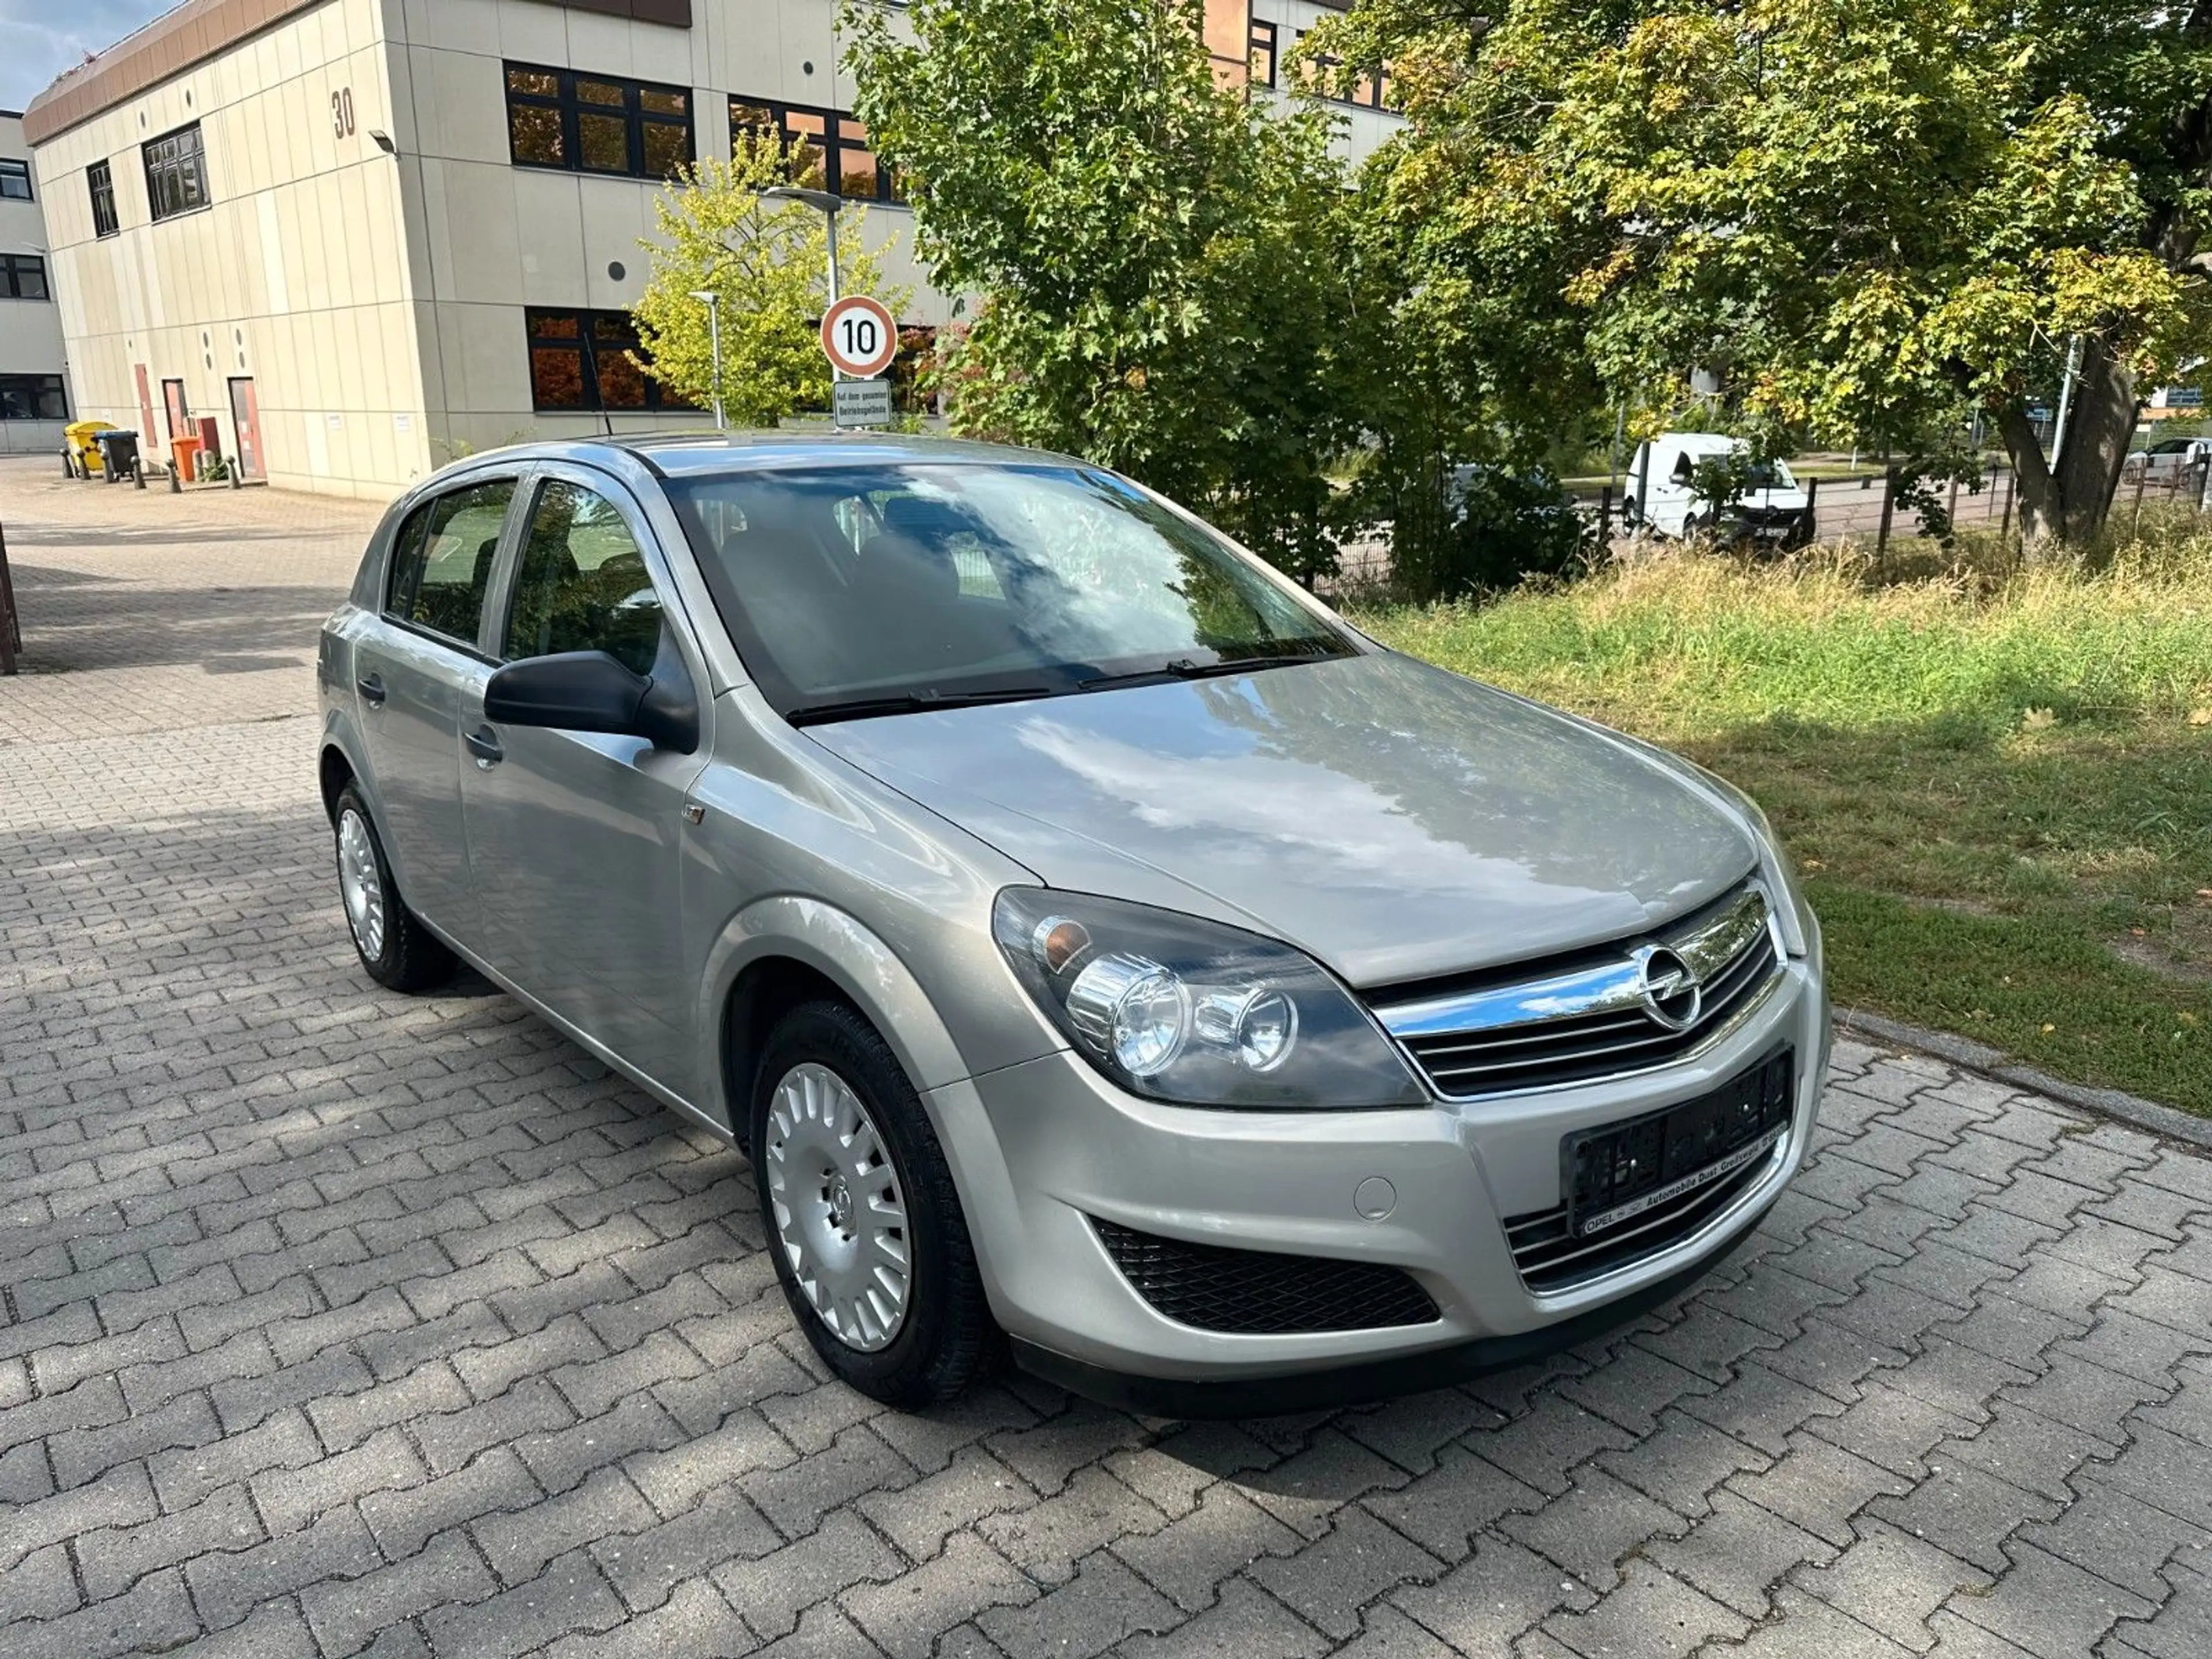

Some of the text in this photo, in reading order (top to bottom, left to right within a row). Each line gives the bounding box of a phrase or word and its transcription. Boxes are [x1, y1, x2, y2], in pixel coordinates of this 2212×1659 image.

[332, 86, 355, 139] 30
[843, 319, 876, 354] 10
[1586, 1214, 1615, 1232] OPEL
[1646, 1176, 1696, 1207] Automobile
